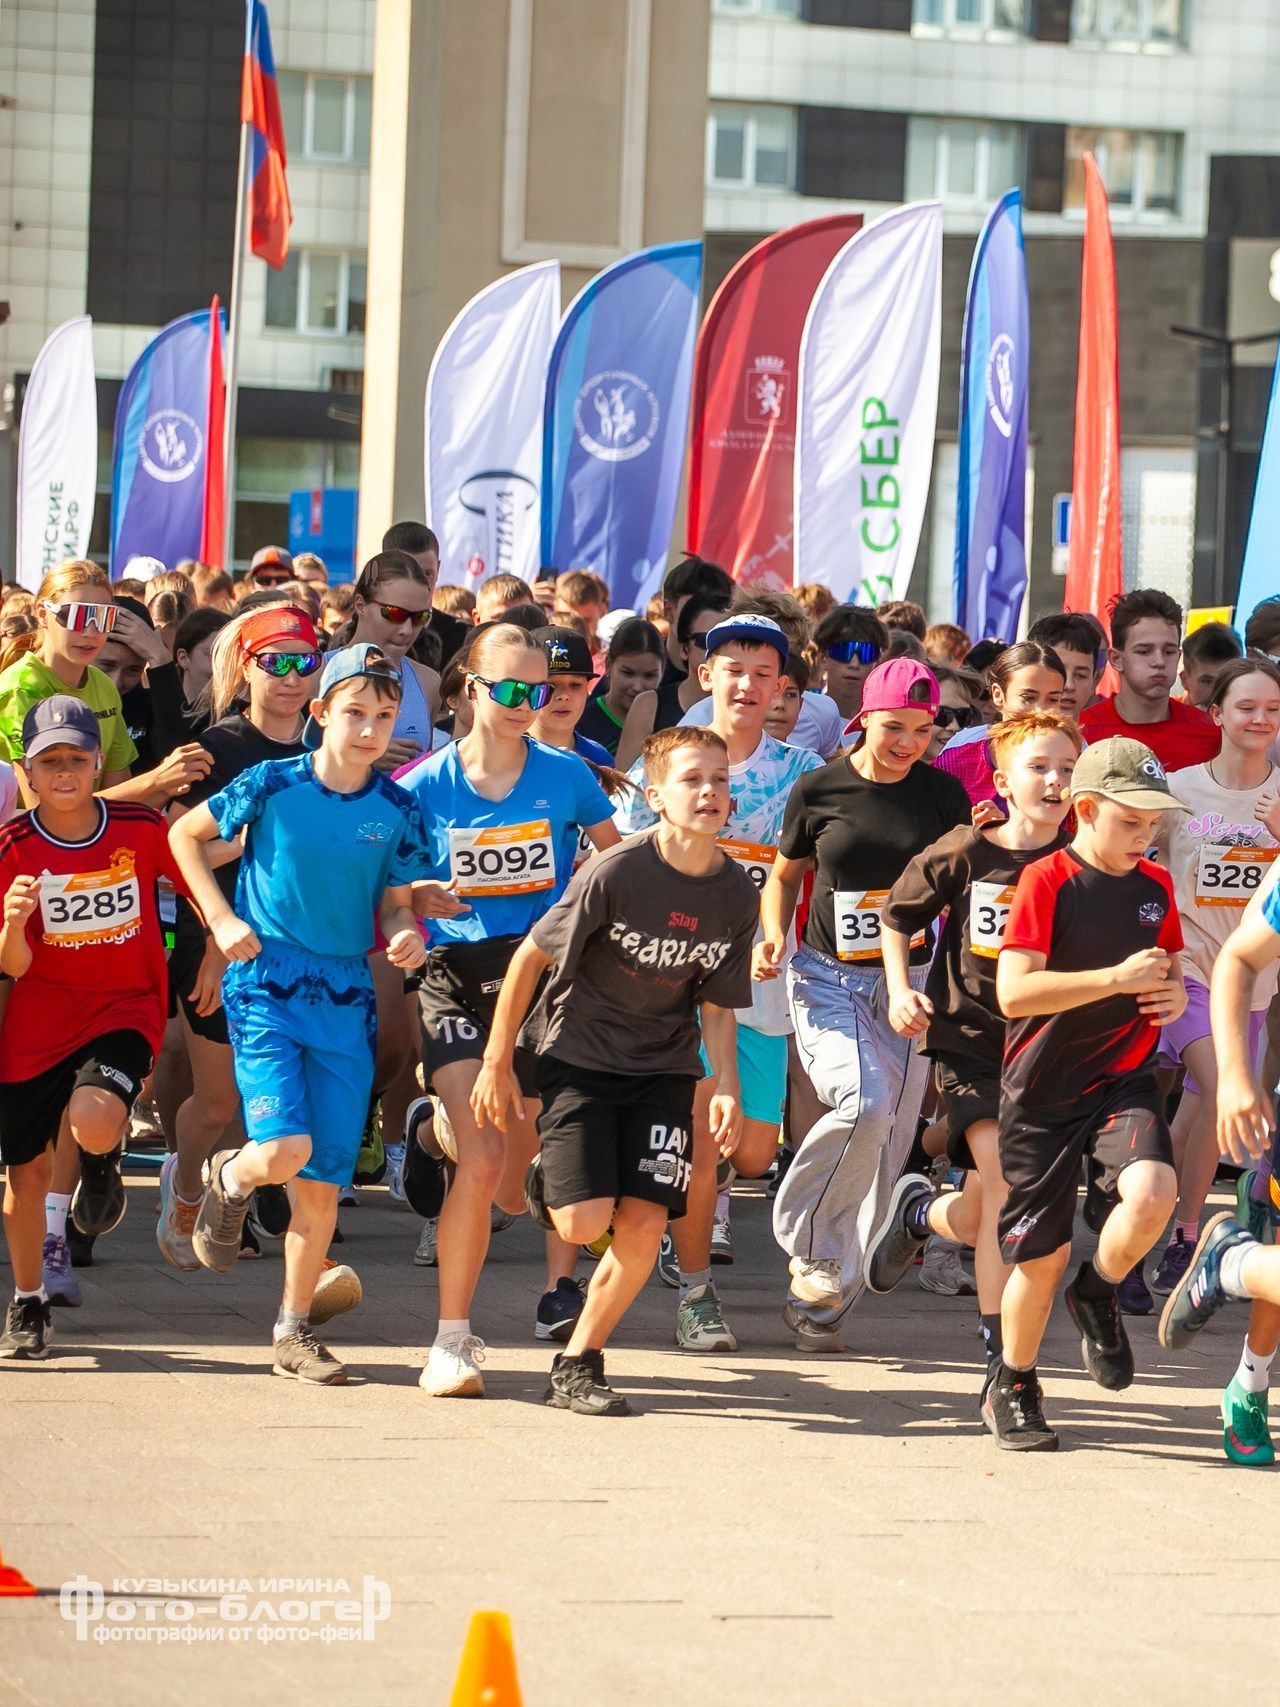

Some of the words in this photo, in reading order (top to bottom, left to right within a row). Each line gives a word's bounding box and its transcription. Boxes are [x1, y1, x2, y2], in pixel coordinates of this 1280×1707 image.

[861, 397, 899, 552] СБЕР
[455, 842, 550, 877] 3092
[1202, 863, 1261, 889] 328
[48, 884, 134, 923] 3285
[668, 911, 698, 932] Slay
[842, 912, 881, 940] 33
[436, 1016, 478, 1044] 16
